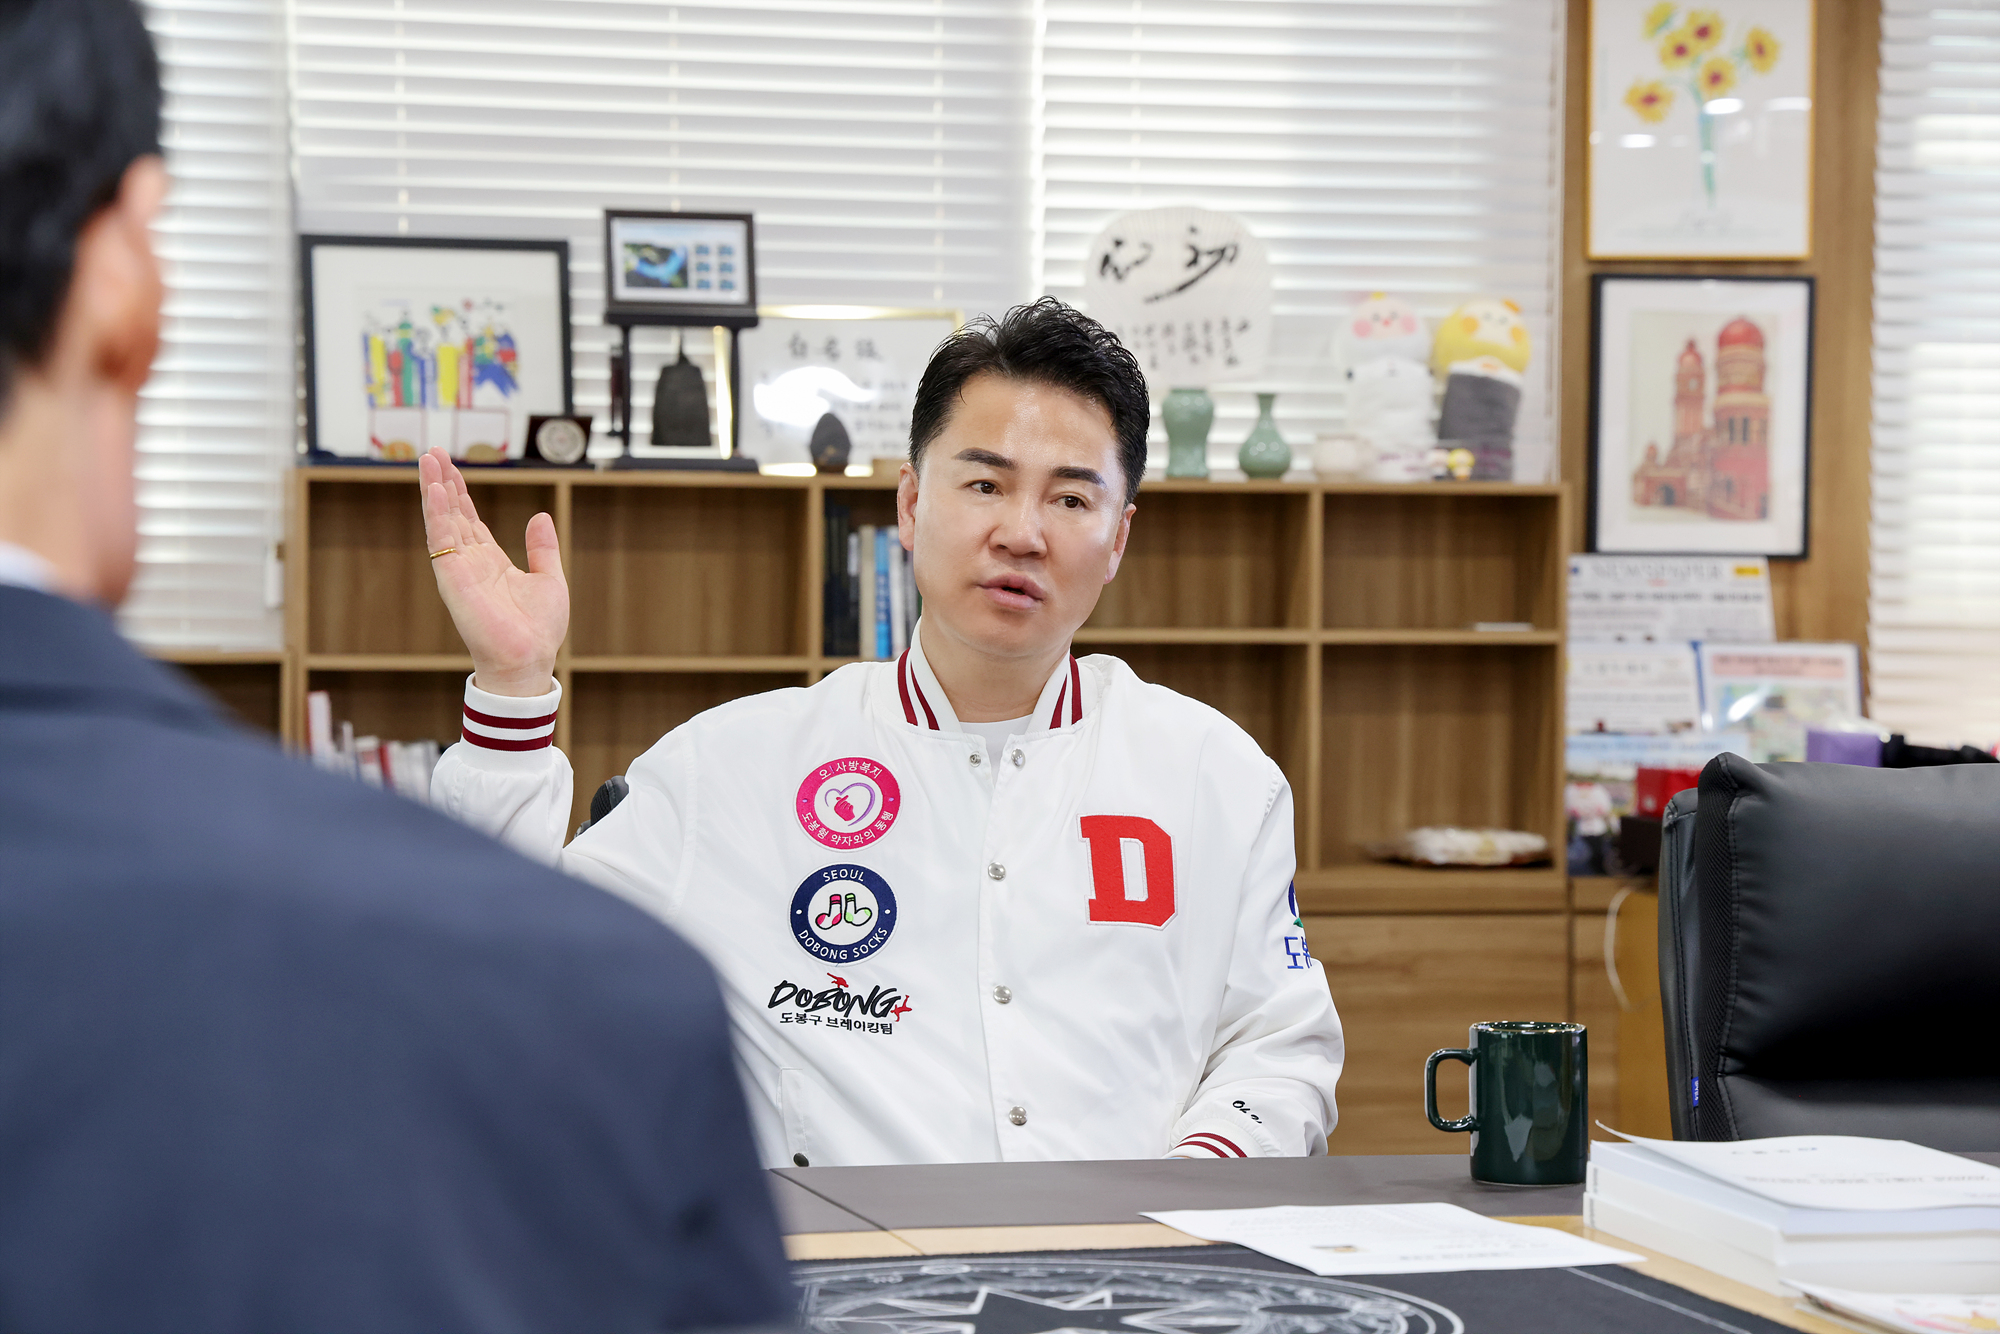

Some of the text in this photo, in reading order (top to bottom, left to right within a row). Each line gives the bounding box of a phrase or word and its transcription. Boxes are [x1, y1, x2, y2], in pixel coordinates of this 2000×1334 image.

[801, 810, 894, 846] 도봉형 약자와의 동행
[823, 868, 864, 882] SEOUL
[1078, 814, 1177, 928] D
[798, 927, 888, 960] DOBONG SOCKS
[767, 980, 902, 1018] DOBONG
[779, 1012, 893, 1035] 도봉구 브레이킹팀
